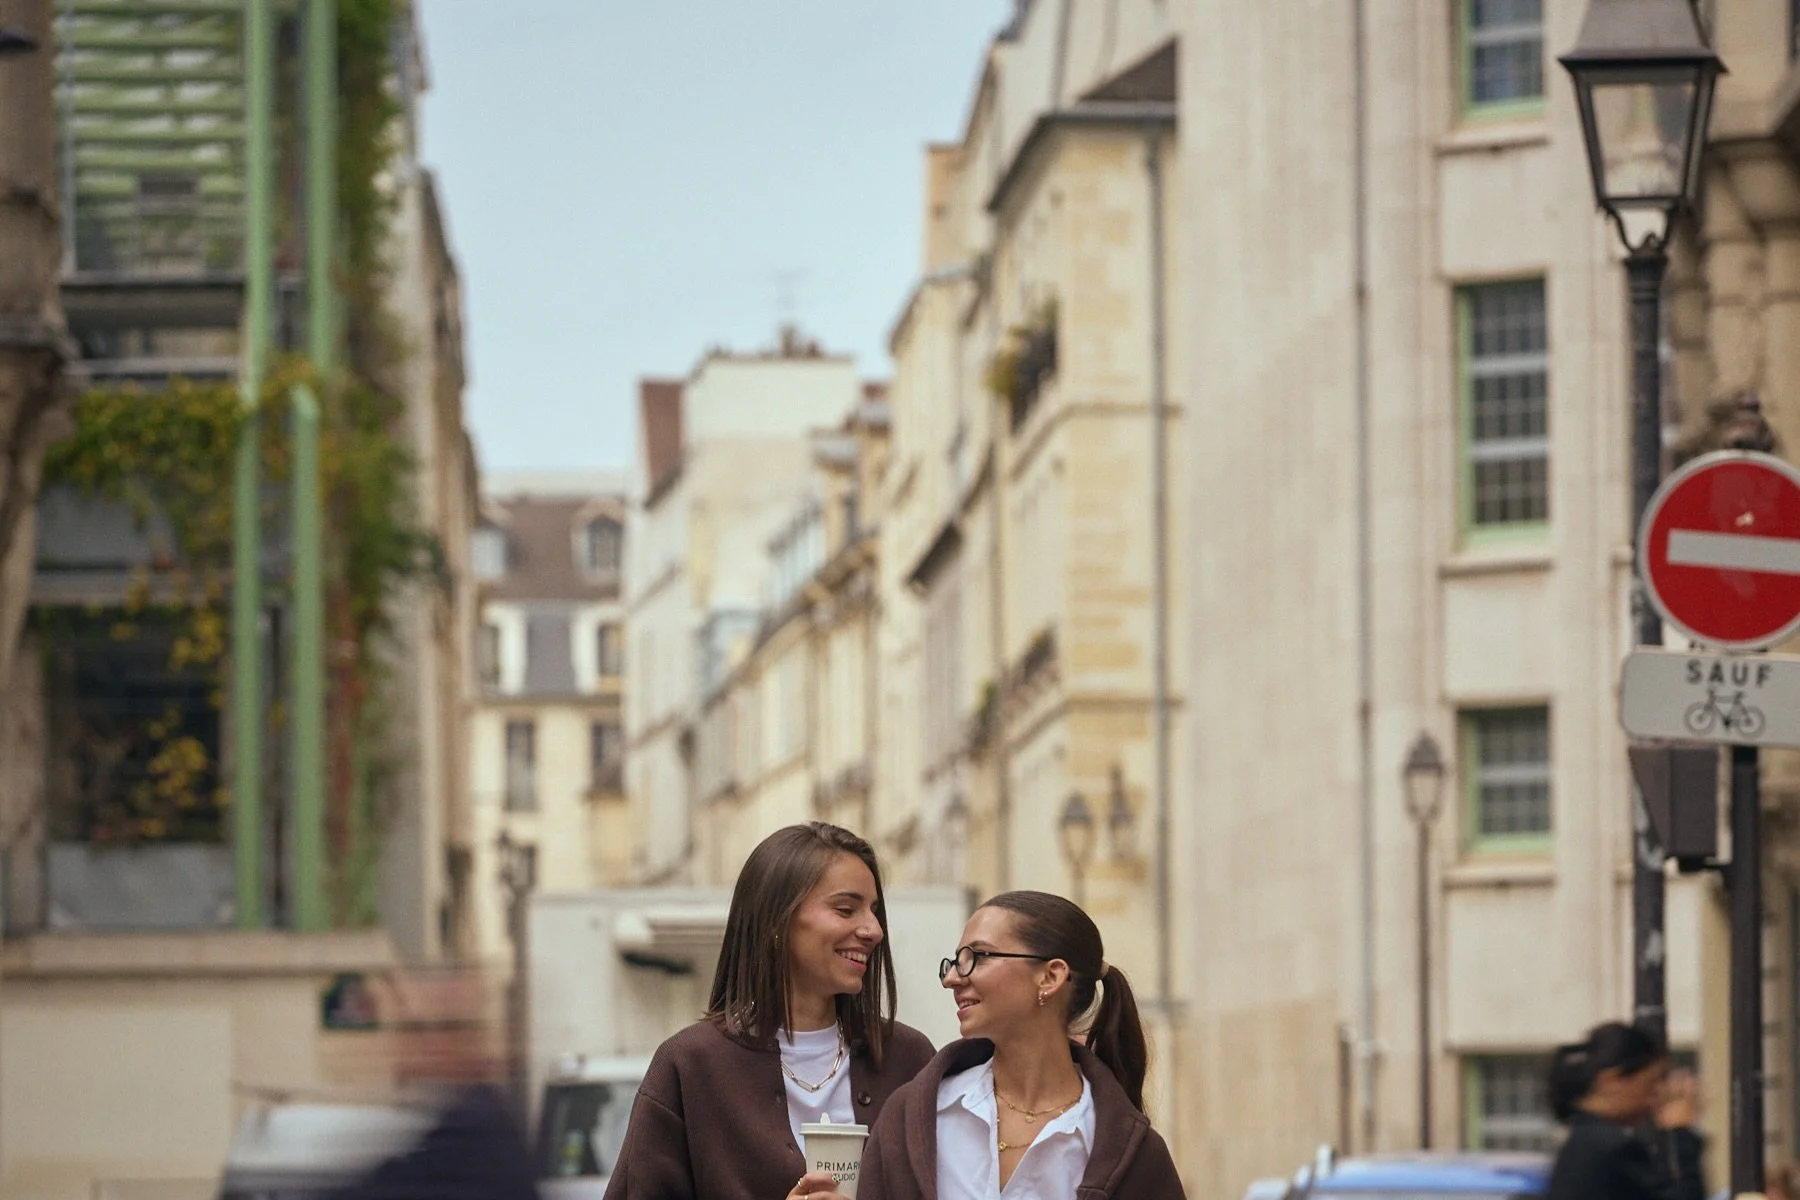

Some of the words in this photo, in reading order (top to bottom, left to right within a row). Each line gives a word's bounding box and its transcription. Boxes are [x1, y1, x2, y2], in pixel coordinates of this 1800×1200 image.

[1686, 659, 1773, 687] SAUF
[816, 1161, 860, 1171] PRIMAR
[833, 1172, 856, 1181] UDIO
